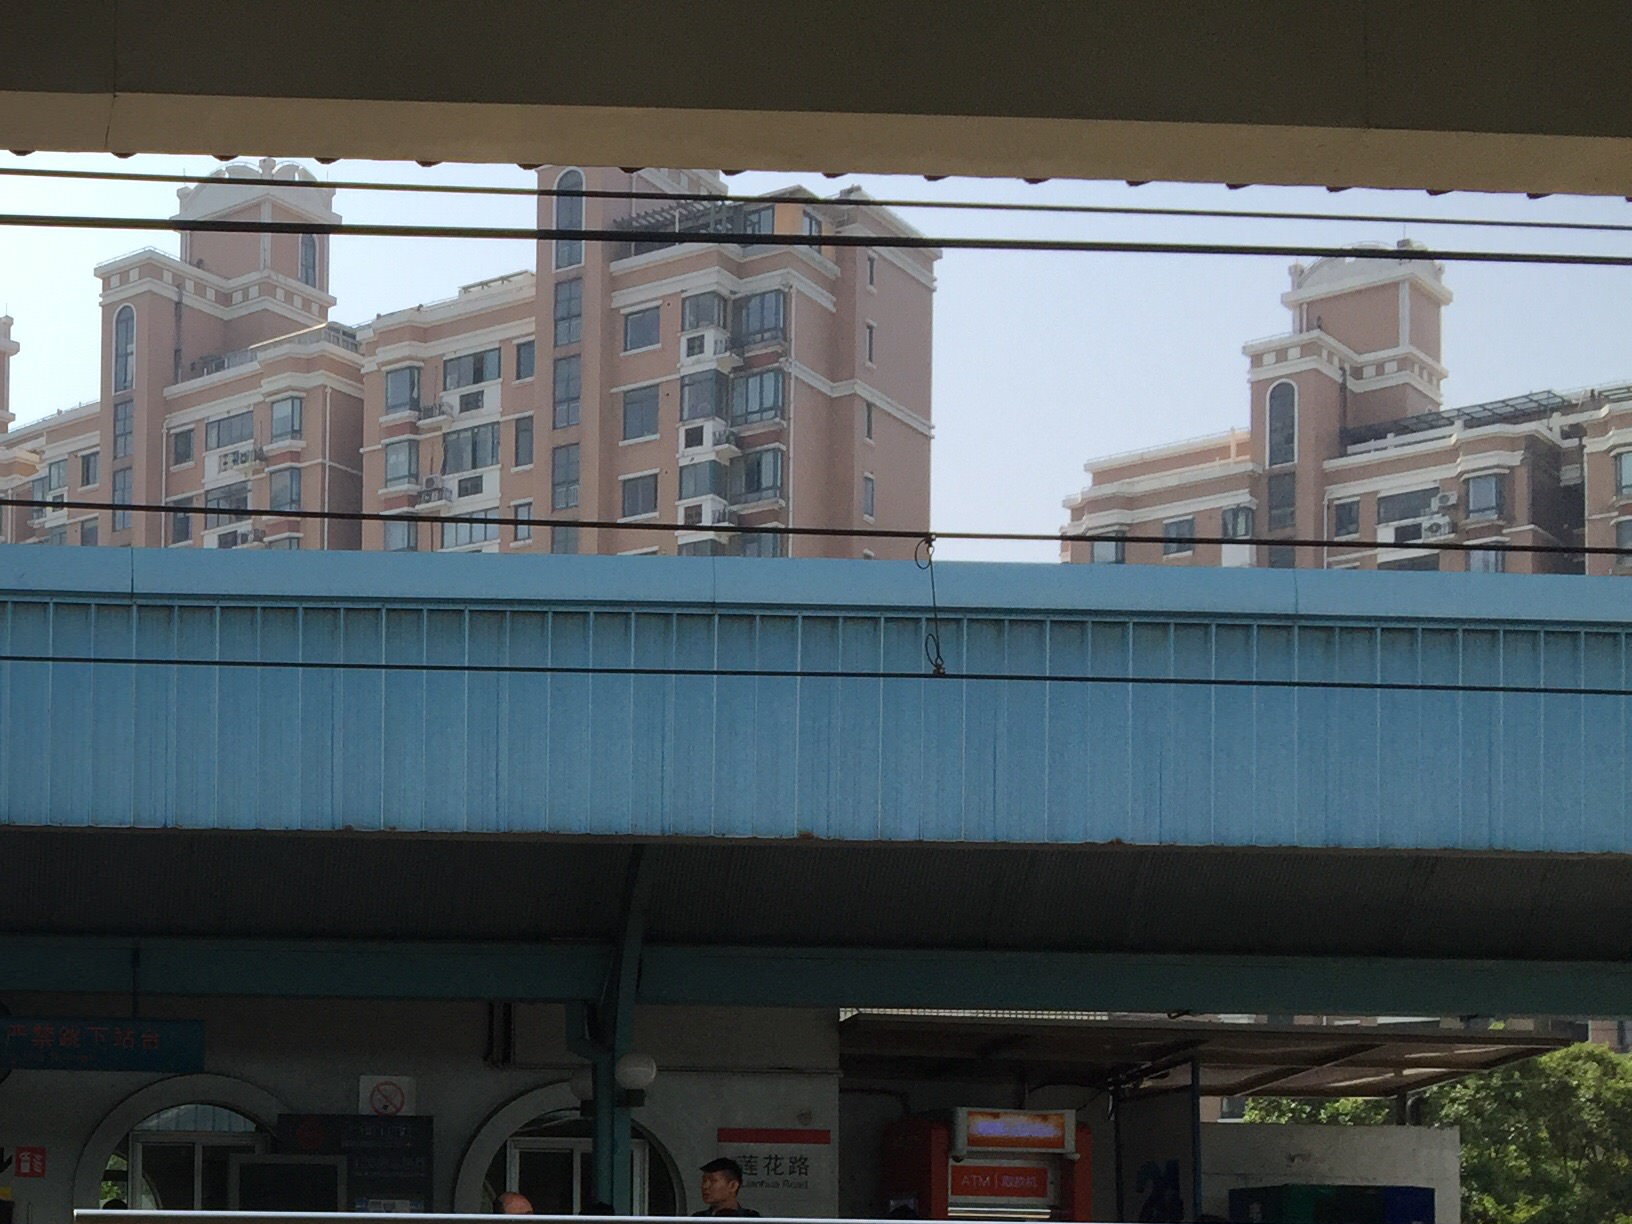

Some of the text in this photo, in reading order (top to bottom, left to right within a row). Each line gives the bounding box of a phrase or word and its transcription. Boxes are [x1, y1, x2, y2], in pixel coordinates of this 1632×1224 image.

[737, 1154, 810, 1177] 莲花路
[960, 1174, 991, 1188] ATM
